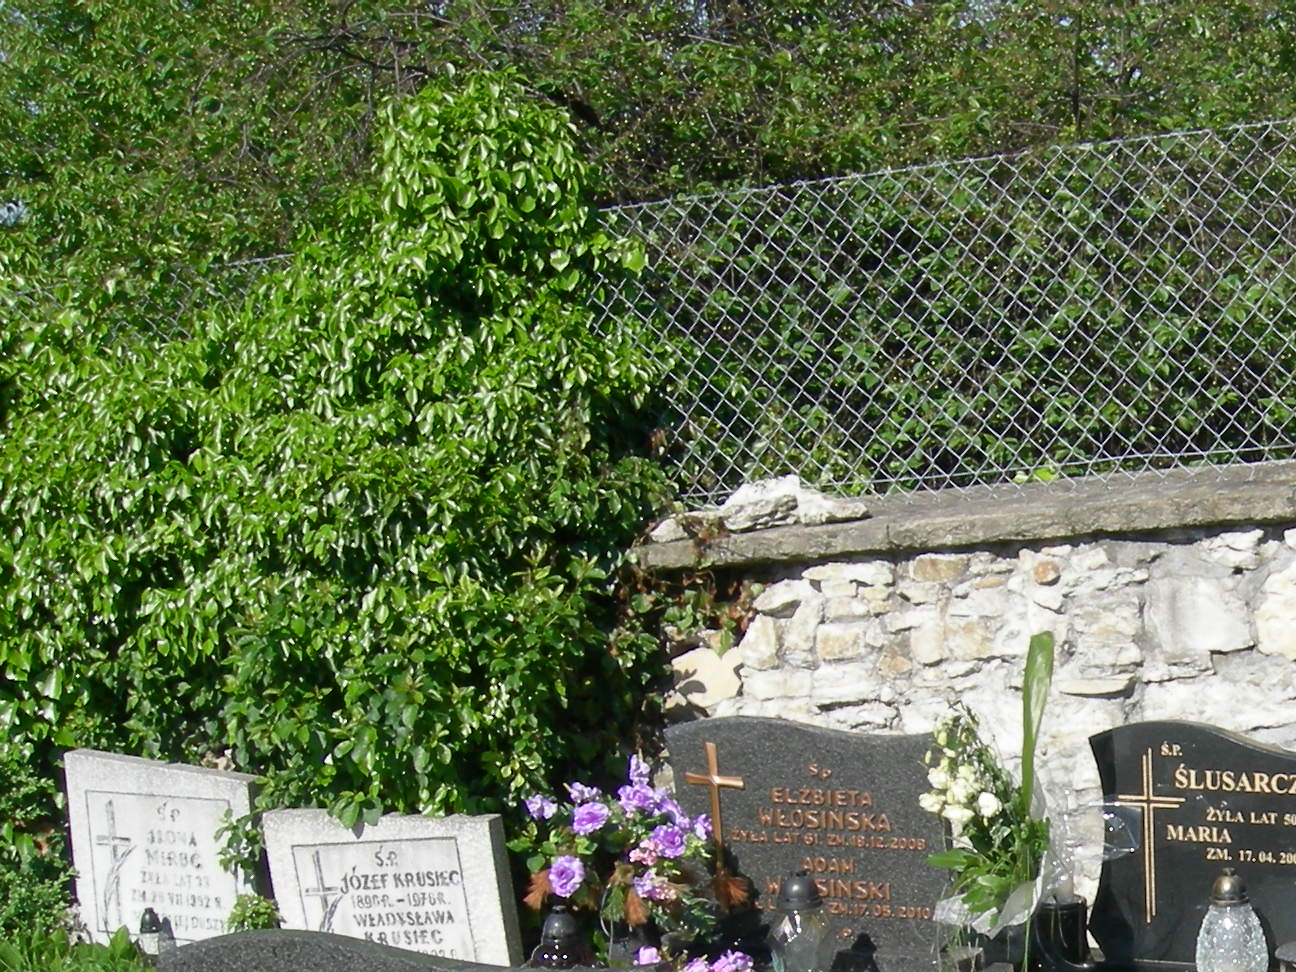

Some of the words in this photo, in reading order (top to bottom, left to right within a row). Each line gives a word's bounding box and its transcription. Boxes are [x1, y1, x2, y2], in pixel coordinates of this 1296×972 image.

[1160, 741, 1183, 756] Ś.P.
[771, 785, 873, 808] ELŻBIETA
[756, 807, 892, 832] WŁOSIŃSKA
[1206, 806, 1244, 823] ŻYŁA
[1250, 812, 1278, 825] LAT
[773, 831, 801, 845] LAT
[1166, 824, 1232, 844] MARIA
[1206, 847, 1232, 861] ZM.
[801, 856, 856, 873] ADAM
[340, 865, 388, 894] JÓZEF
[393, 870, 460, 888] KRUSIEC
[353, 910, 454, 927] WŁADYSŁAWA
